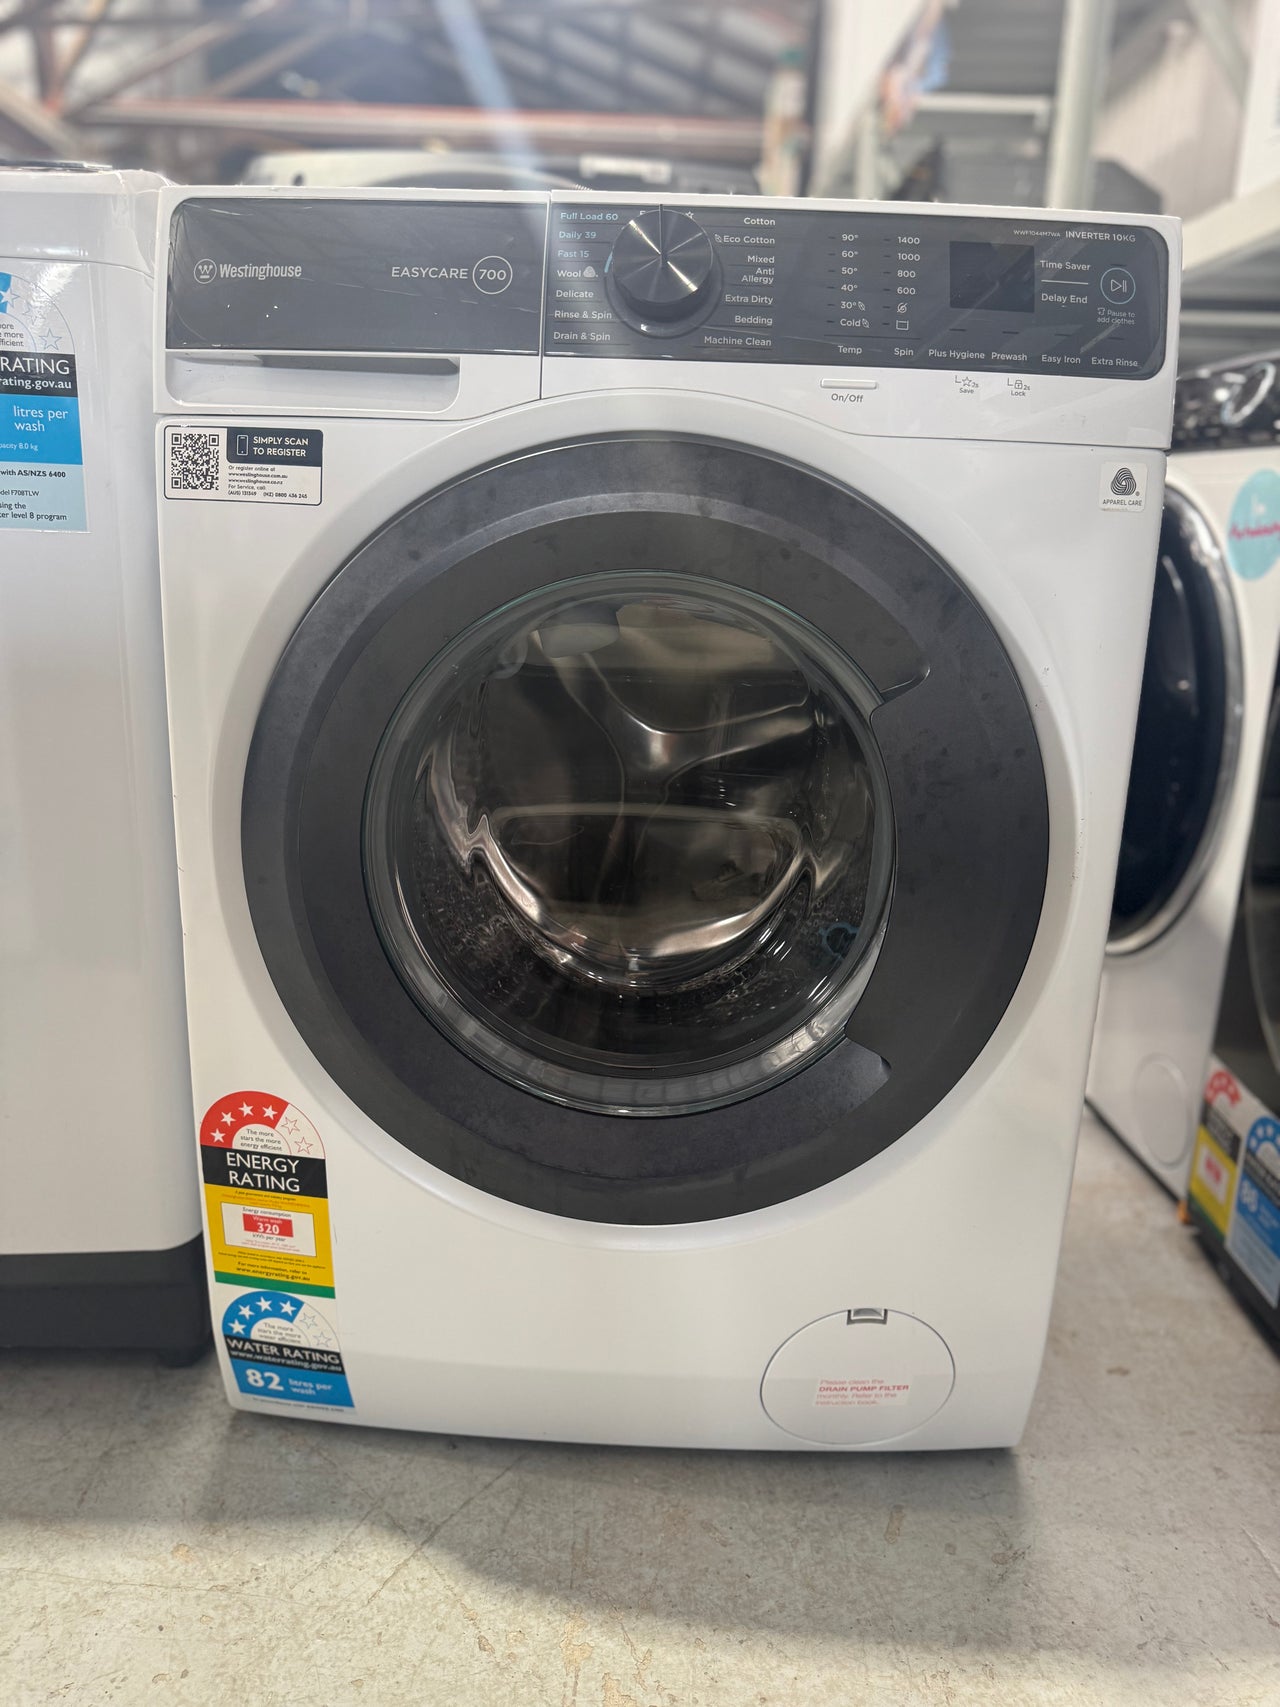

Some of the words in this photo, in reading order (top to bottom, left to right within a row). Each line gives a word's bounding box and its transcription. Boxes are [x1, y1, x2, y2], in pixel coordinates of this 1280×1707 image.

[744, 218, 775, 226] Cotton
[559, 231, 582, 239] Daily
[723, 235, 740, 243] Eco
[743, 236, 775, 244] Cotton
[1066, 231, 1110, 240] INVERTER
[1113, 233, 1136, 242] 10KG
[898, 236, 920, 244] 1400
[898, 253, 920, 261] 1000
[1040, 260, 1062, 269] Time
[1065, 262, 1091, 271] Saver
[220, 264, 302, 280] Westinghouse
[391, 267, 468, 279] EASYCARE
[479, 269, 506, 280] 700
[842, 267, 857, 275] 50°
[897, 270, 916, 278] 800
[741, 275, 774, 284] Allergy
[556, 290, 594, 298] Delicate
[897, 287, 916, 295] 600
[726, 295, 748, 303] Extra
[752, 295, 773, 304] Dirty
[1041, 293, 1067, 304] Delay
[1070, 295, 1088, 304] End
[841, 301, 856, 309] 30°
[555, 310, 579, 318] Rinse
[592, 311, 612, 320] Spin
[735, 316, 773, 325] Bedding
[840, 319, 861, 327] Cold
[554, 332, 578, 340] Drain
[590, 333, 610, 341] Spin
[704, 336, 742, 345] Machine
[746, 337, 771, 346] Clean
[837, 346, 862, 355] Temp
[894, 348, 914, 357] Spin
[928, 349, 947, 358] Plus
[949, 350, 985, 359] Hygiene
[991, 352, 1027, 361] Prewash
[1042, 355, 1061, 364] Easy
[1064, 356, 1081, 364] Iron
[0, 357, 70, 375] RATING
[1091, 357, 1113, 366] Extra
[1116, 358, 1138, 367] Rinse
[831, 393, 864, 403] On/Off
[13, 405, 44, 418] litres
[48, 410, 68, 421] per
[14, 420, 45, 431] wash
[253, 436, 283, 445] SIMPLY
[284, 437, 308, 445] SCAN
[30, 443, 38, 451] kg
[267, 448, 306, 457] REGISTER
[226, 1152, 300, 1174] ENERGY
[229, 1170, 300, 1192] RATING
[258, 1222, 280, 1234] 320
[226, 1338, 279, 1355] WATER
[283, 1347, 339, 1364] RATING
[246, 1368, 284, 1391] 82
